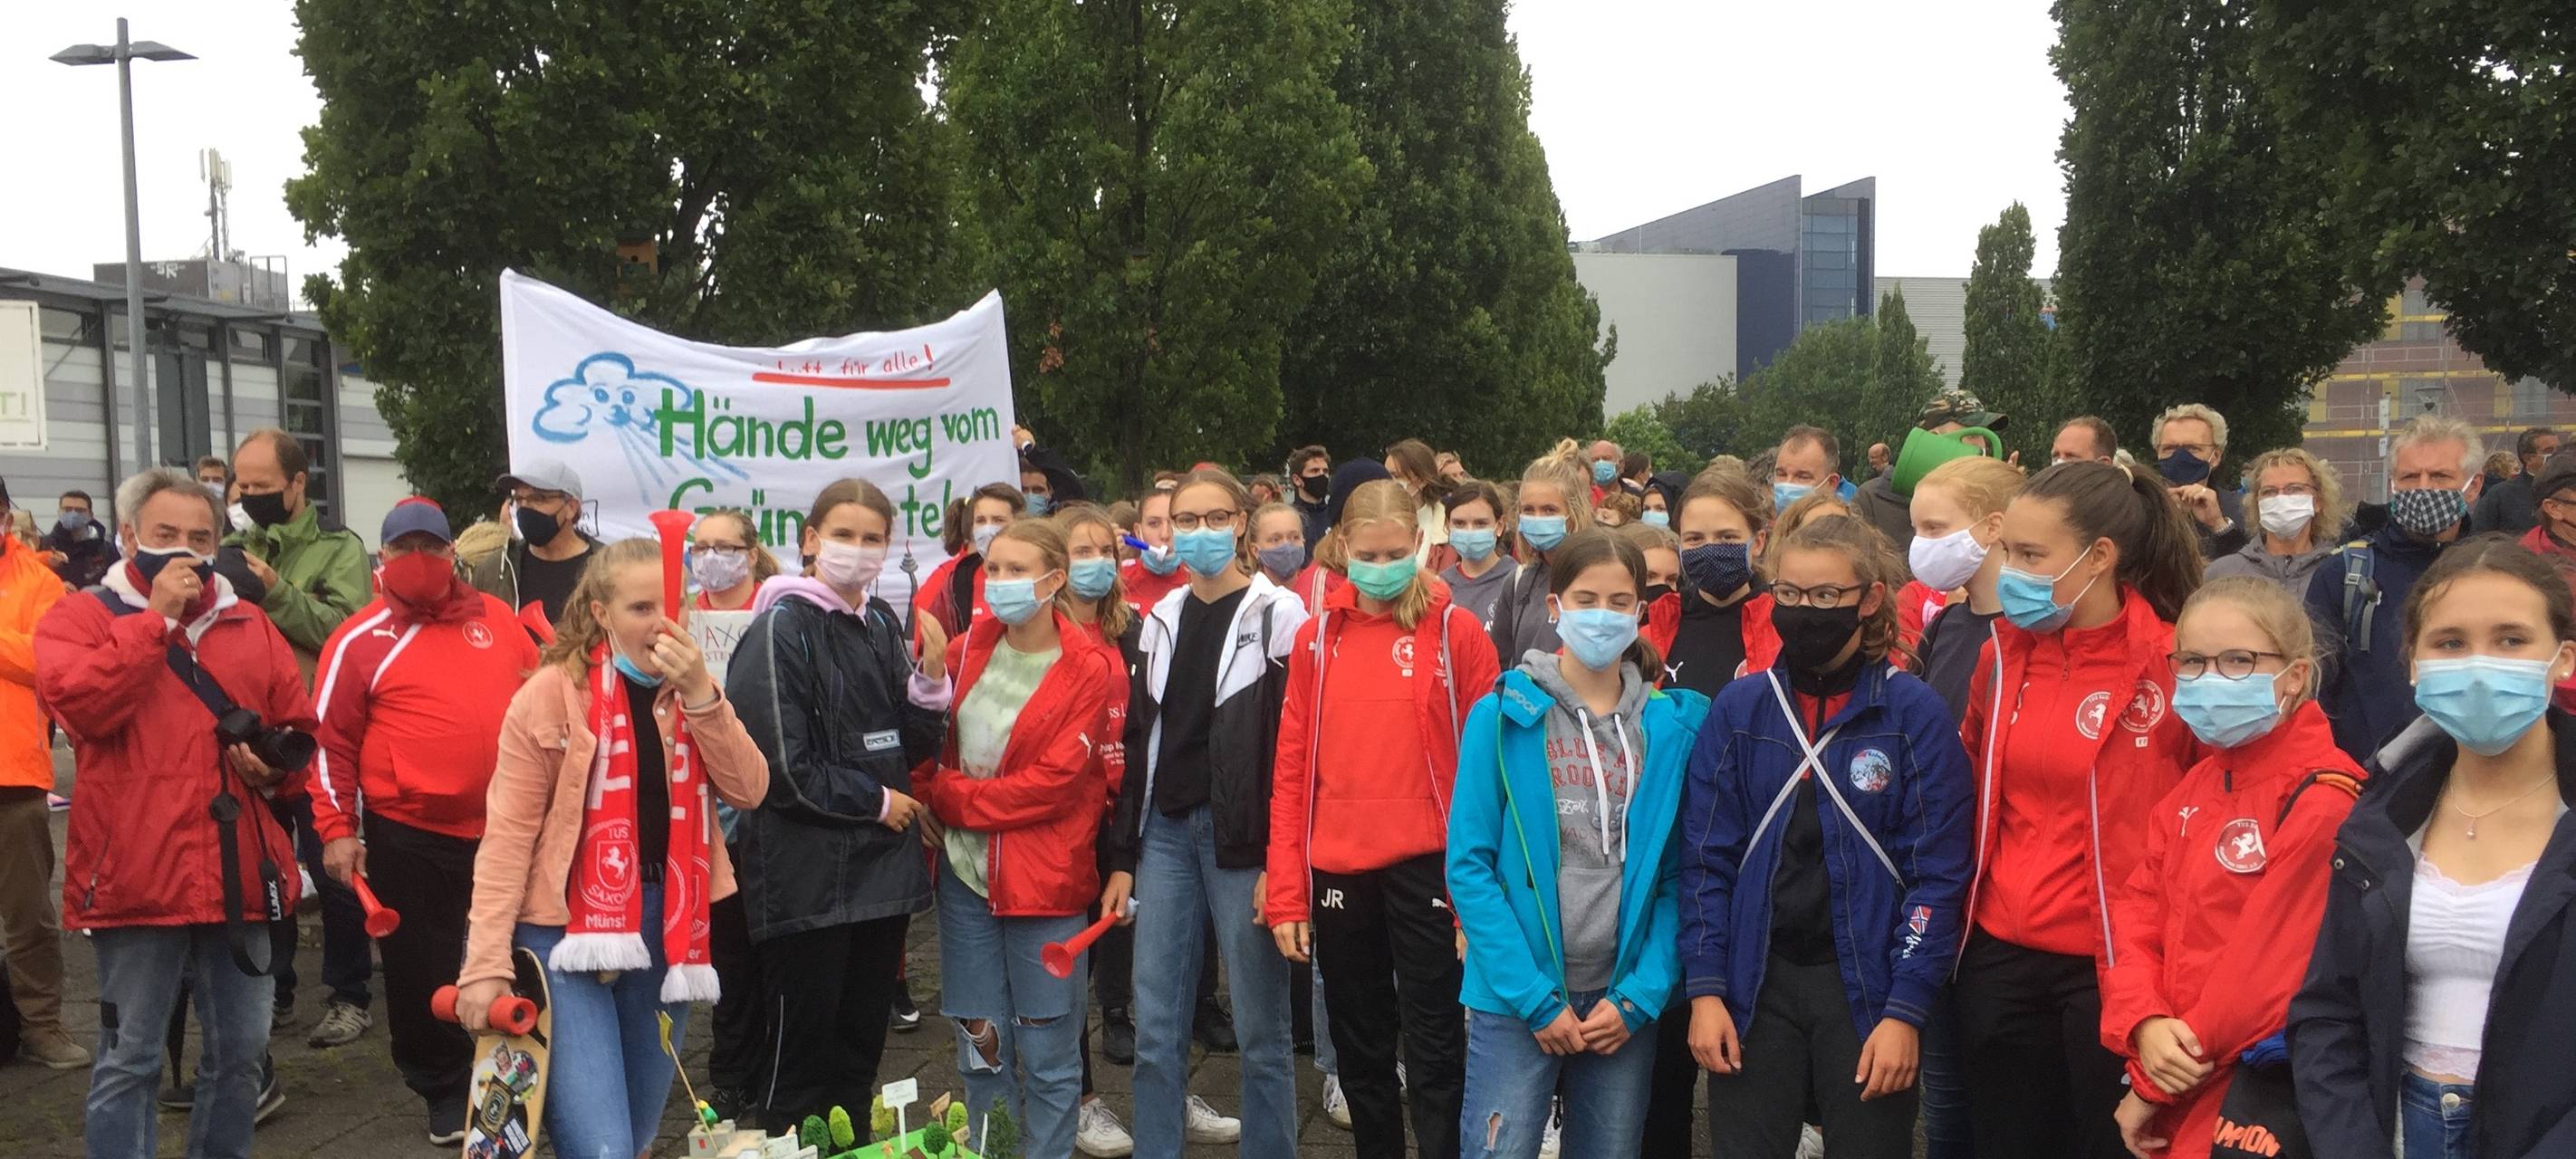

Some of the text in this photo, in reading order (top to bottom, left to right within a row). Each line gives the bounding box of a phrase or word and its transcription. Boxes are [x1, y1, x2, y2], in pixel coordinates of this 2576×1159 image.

[654, 388, 1000, 479] Hände weg vom
[608, 827, 629, 839] TUS
[268, 880, 281, 921] LUMIX
[1321, 887, 1345, 910] JR
